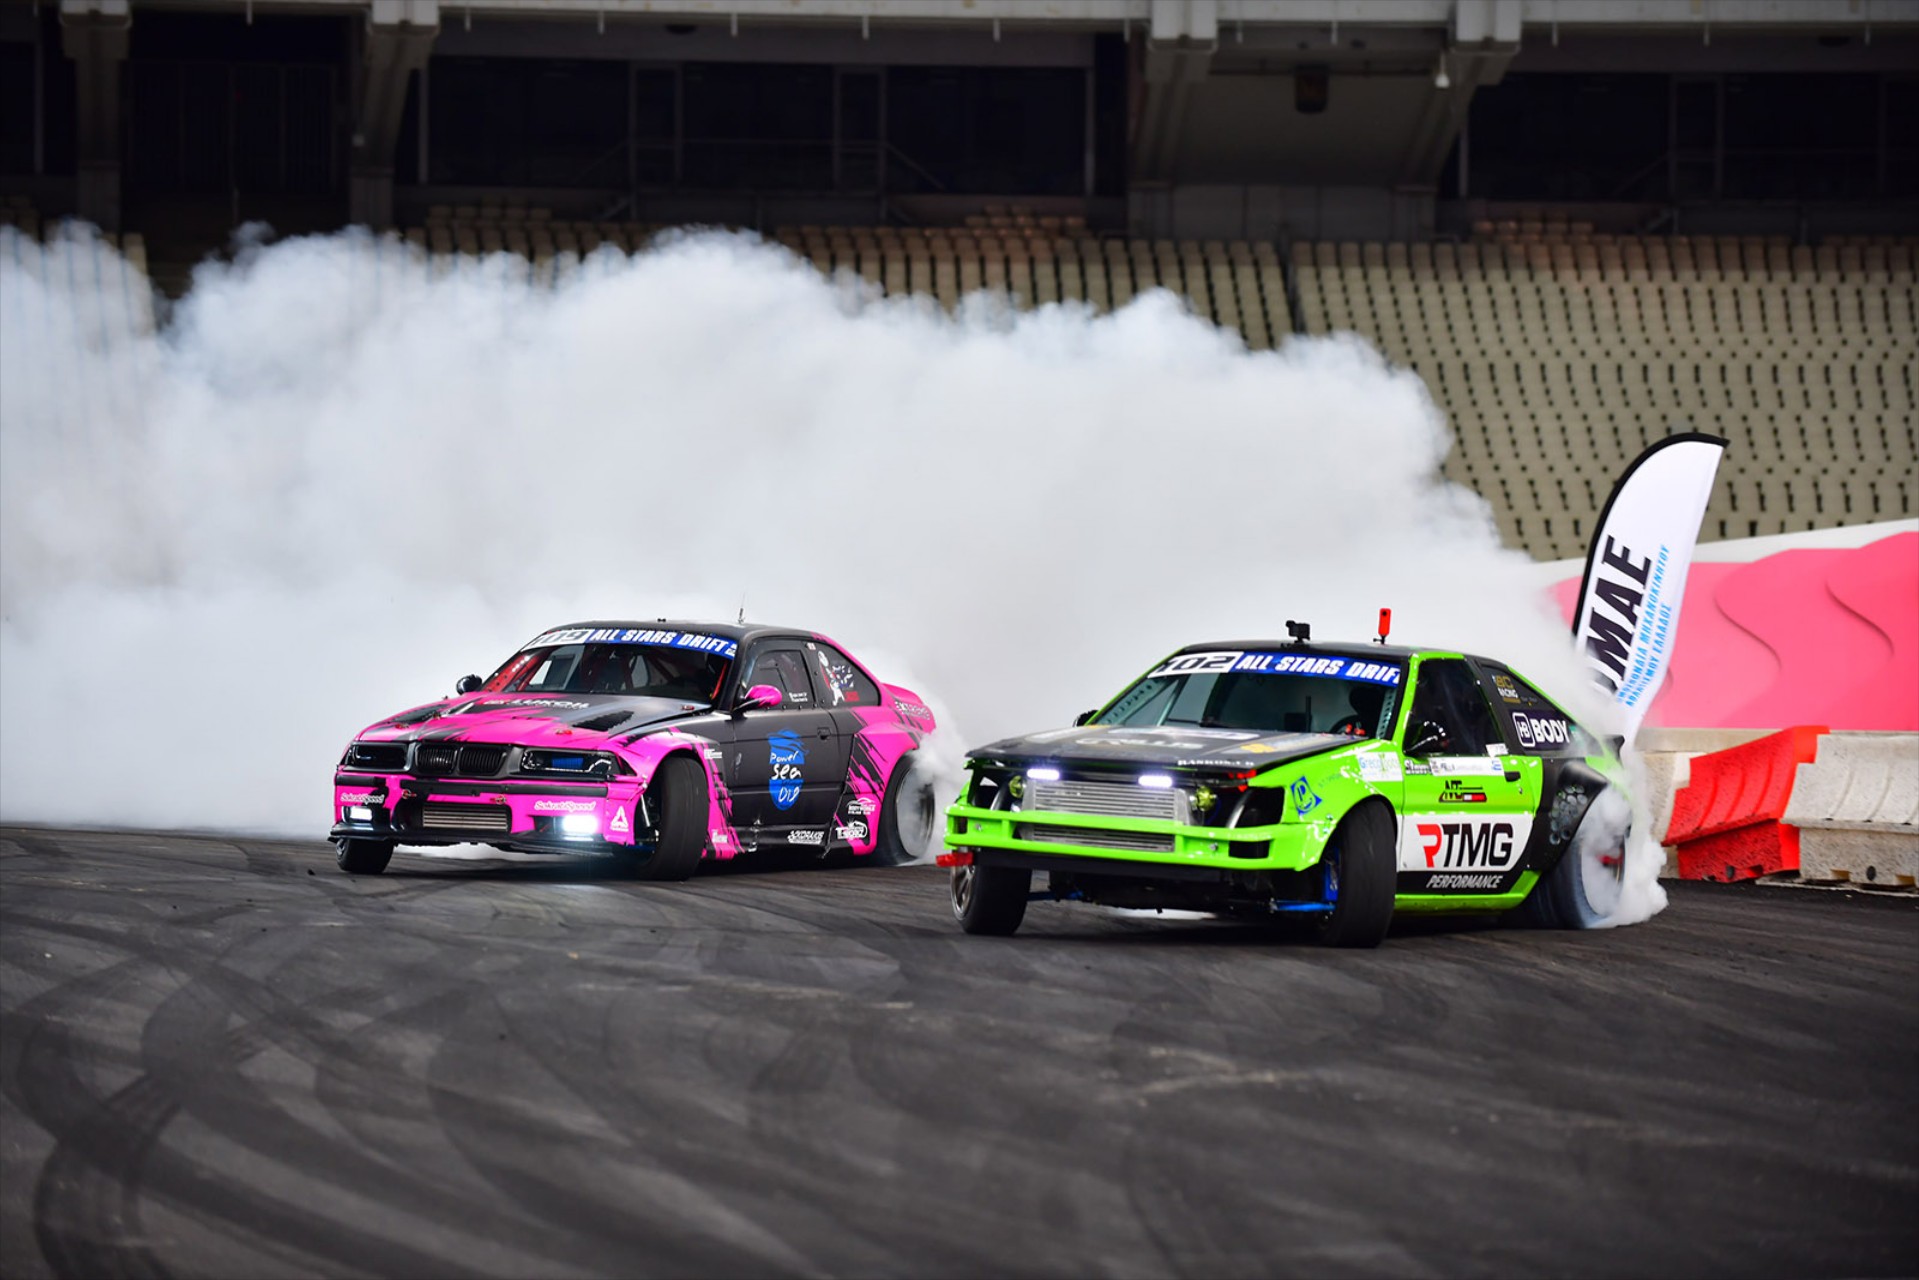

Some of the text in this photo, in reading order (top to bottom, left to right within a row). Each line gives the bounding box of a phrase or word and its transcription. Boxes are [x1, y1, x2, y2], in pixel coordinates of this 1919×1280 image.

[1652, 603, 1672, 654] ΕΛΛΑΔΟΣ
[589, 630, 618, 641] ALL
[621, 630, 674, 643] STARS
[677, 634, 729, 652] DRIFT
[1156, 655, 1236, 673] 102
[1236, 655, 1268, 670] ALL
[1275, 656, 1344, 676] STARS
[1529, 718, 1570, 743] BODY
[1416, 823, 1513, 868] RTMG
[1426, 875, 1503, 888] PERFORMANCE
